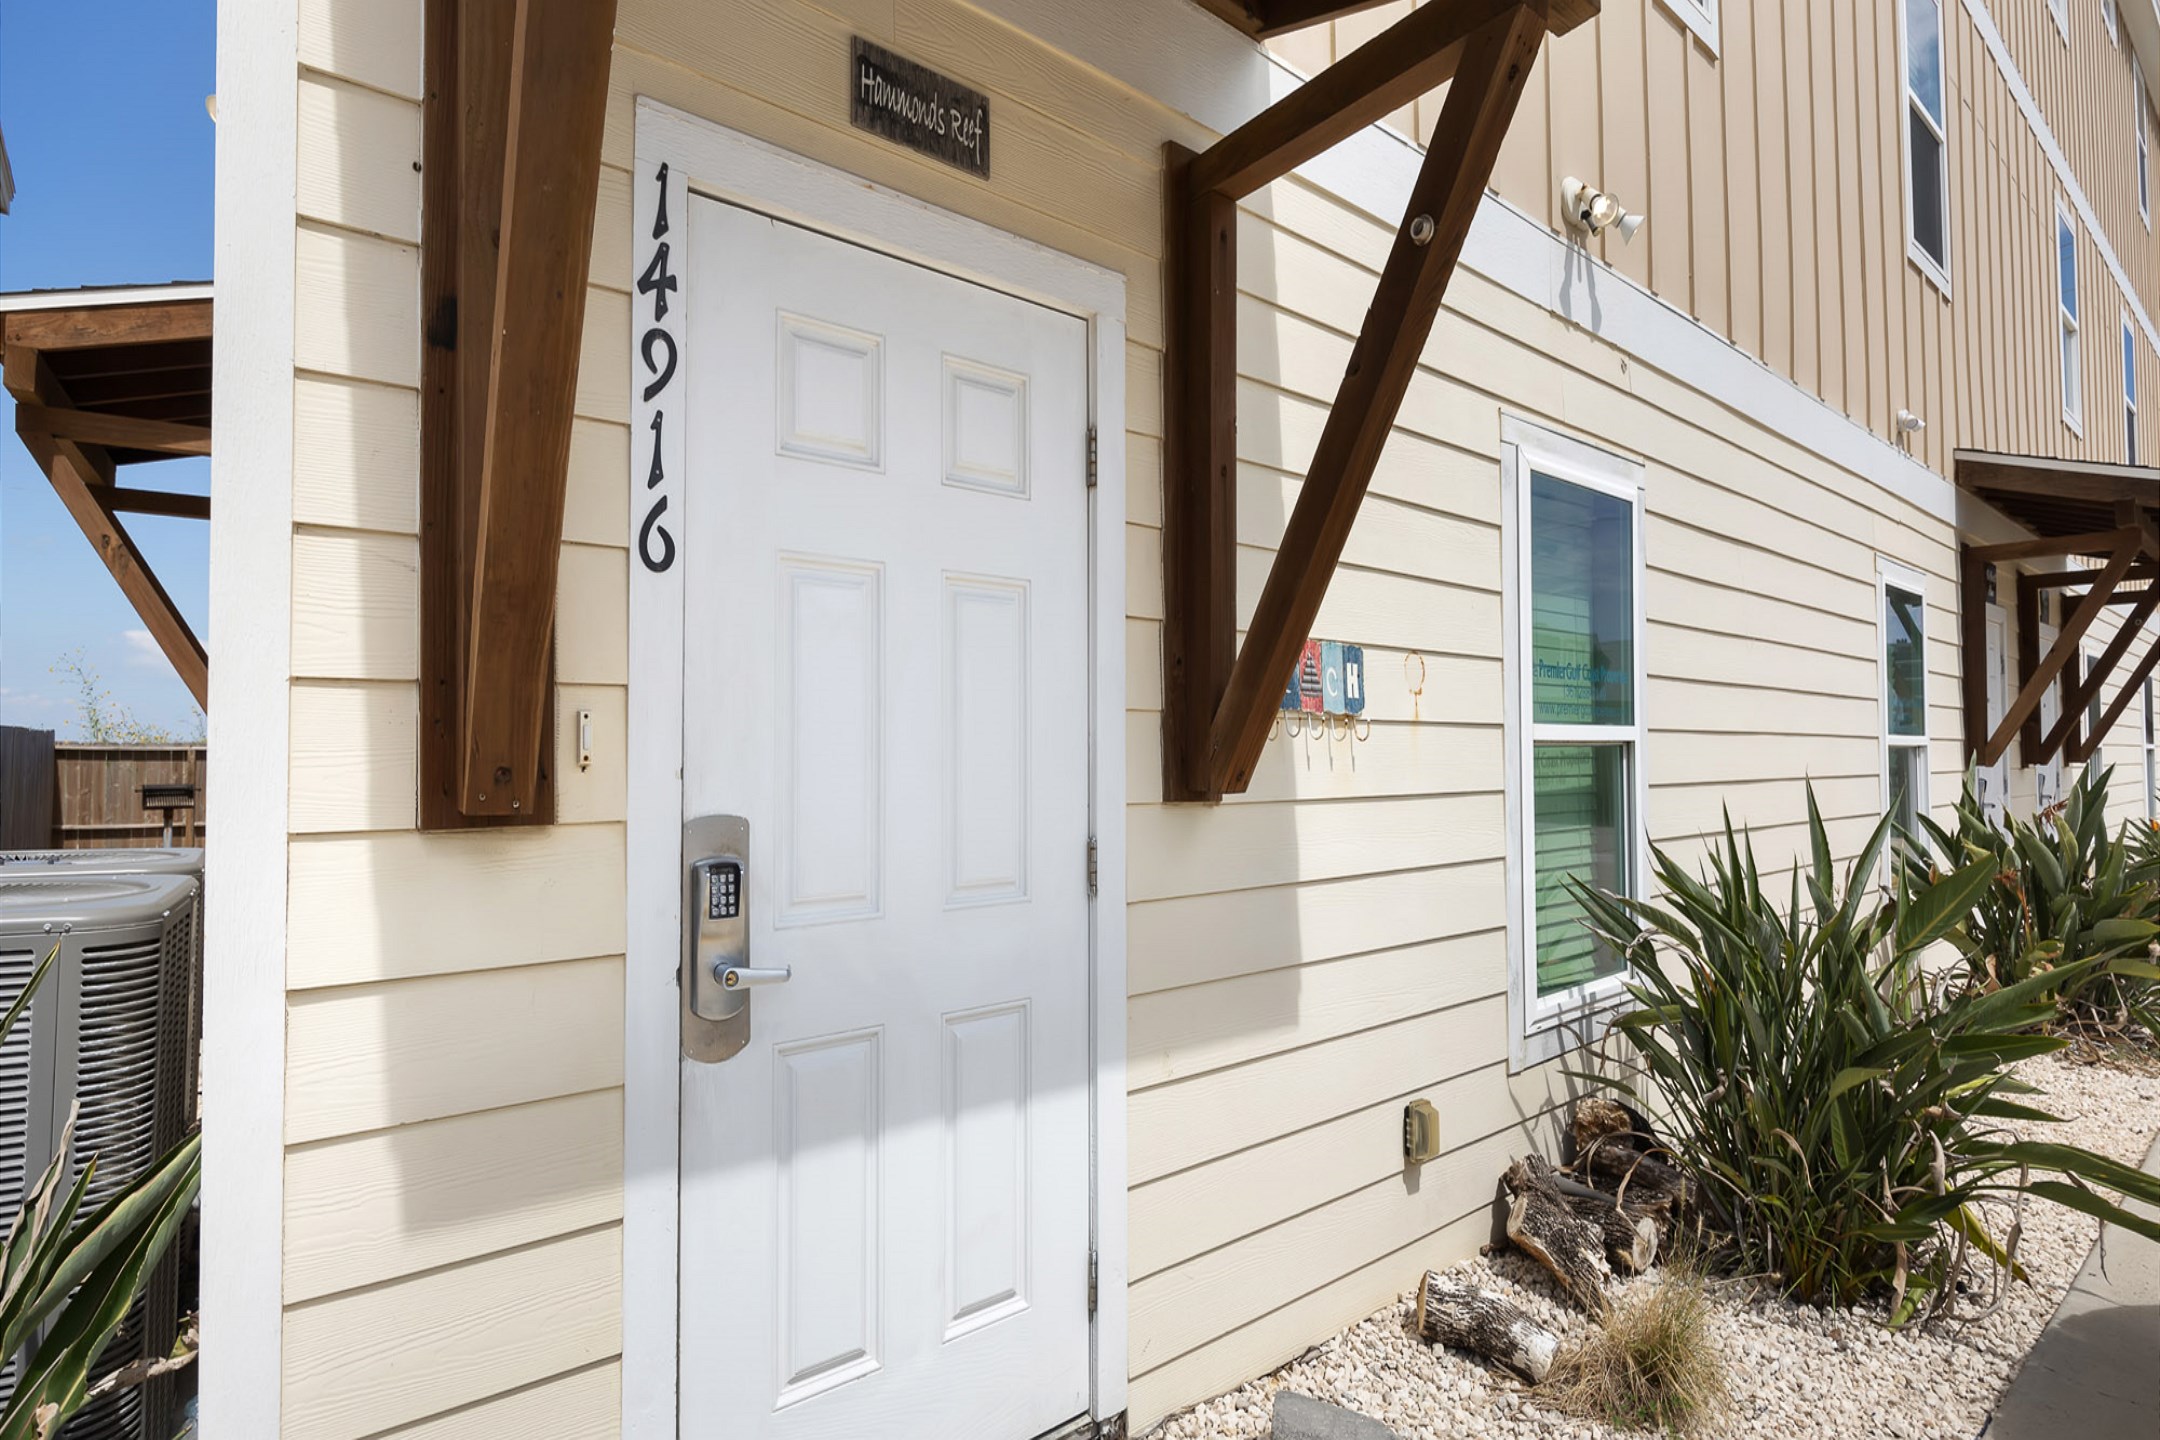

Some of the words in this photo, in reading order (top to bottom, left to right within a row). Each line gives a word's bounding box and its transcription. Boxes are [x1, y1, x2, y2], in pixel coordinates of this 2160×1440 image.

[861, 63, 946, 136] Hammonds
[950, 108, 983, 165] Reef
[636, 161, 678, 573] 14916
